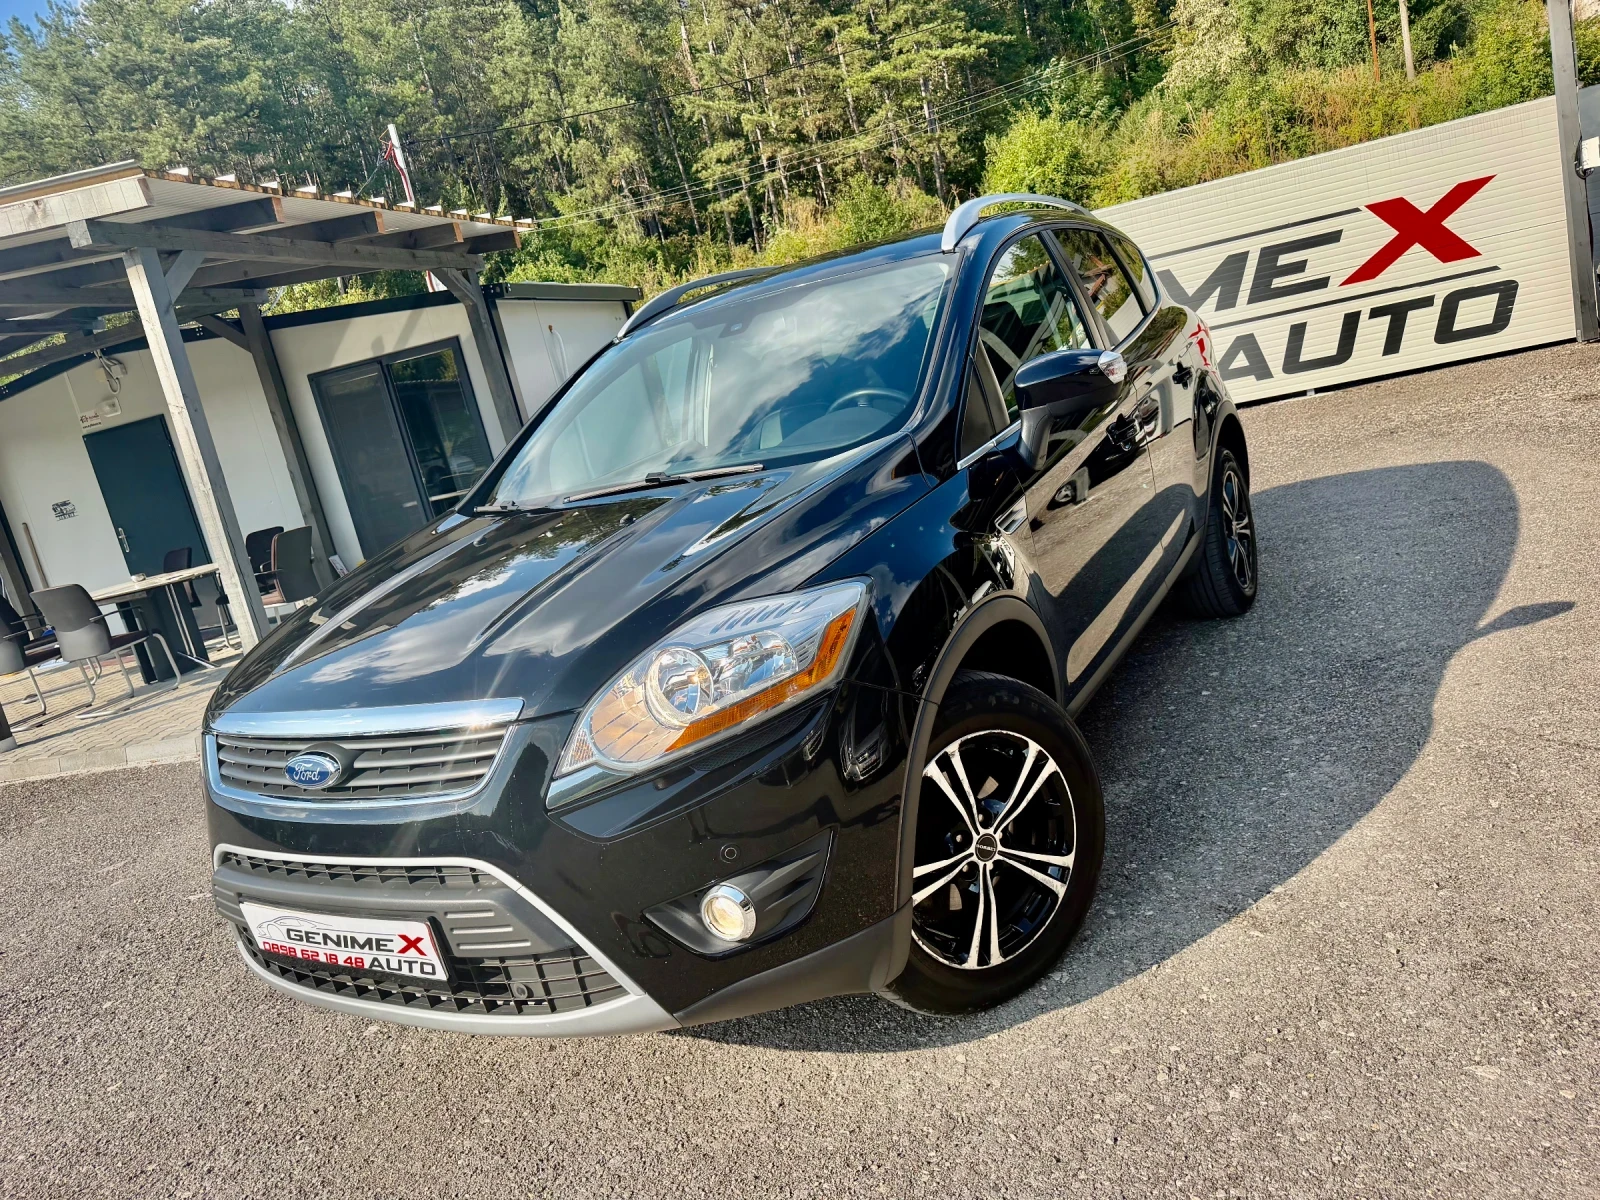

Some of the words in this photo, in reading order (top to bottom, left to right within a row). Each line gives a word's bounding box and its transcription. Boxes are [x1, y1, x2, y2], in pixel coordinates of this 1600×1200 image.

[1219, 279, 1519, 381] AUTO
[293, 762, 320, 781] Ford
[262, 940, 297, 958] 0898
[301, 951, 320, 961] 62
[343, 956, 364, 968] 48
[286, 927, 427, 957] GENIMEX
[368, 957, 436, 976] AUTO
